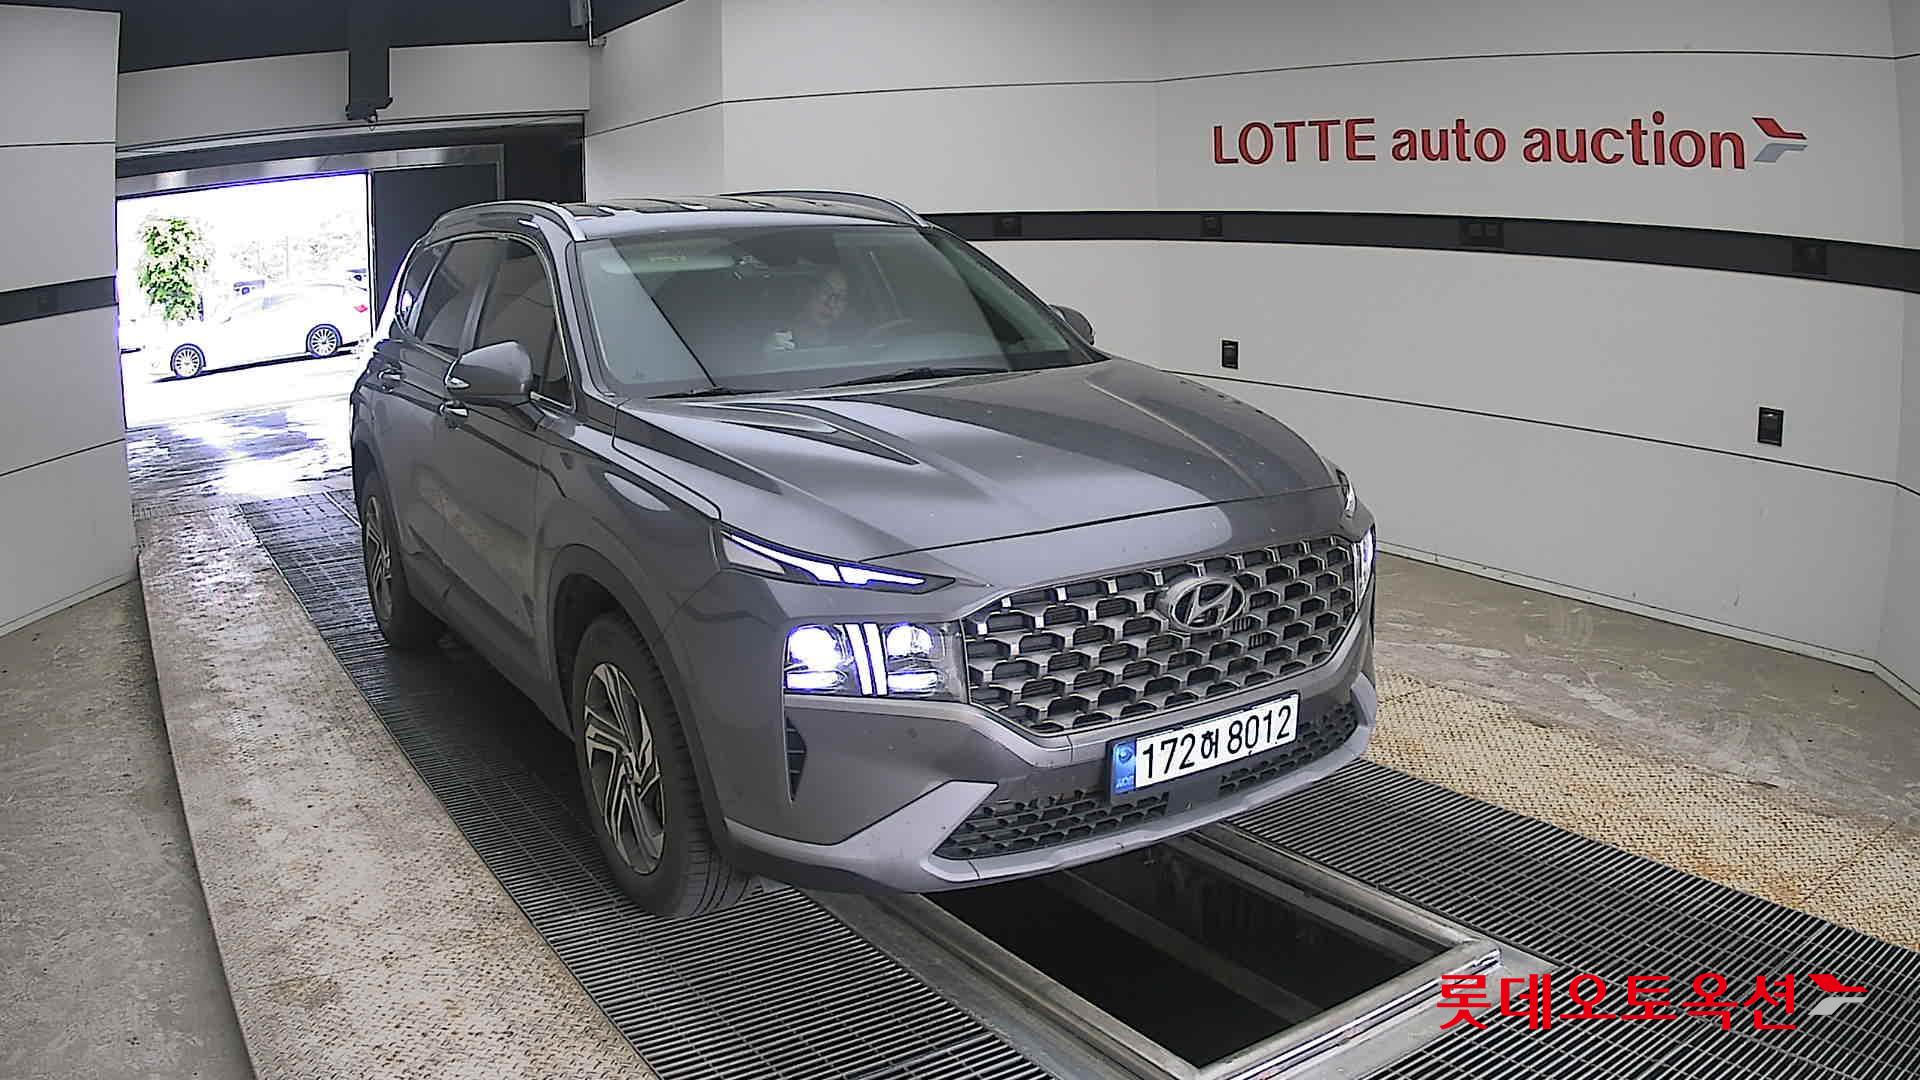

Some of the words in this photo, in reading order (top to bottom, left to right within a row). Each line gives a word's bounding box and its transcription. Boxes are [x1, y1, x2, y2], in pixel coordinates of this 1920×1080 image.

[1213, 118, 1376, 165] LOTTE
[1391, 118, 1507, 162] auto
[1522, 110, 1746, 170] auction
[1228, 705, 1291, 754] 8012
